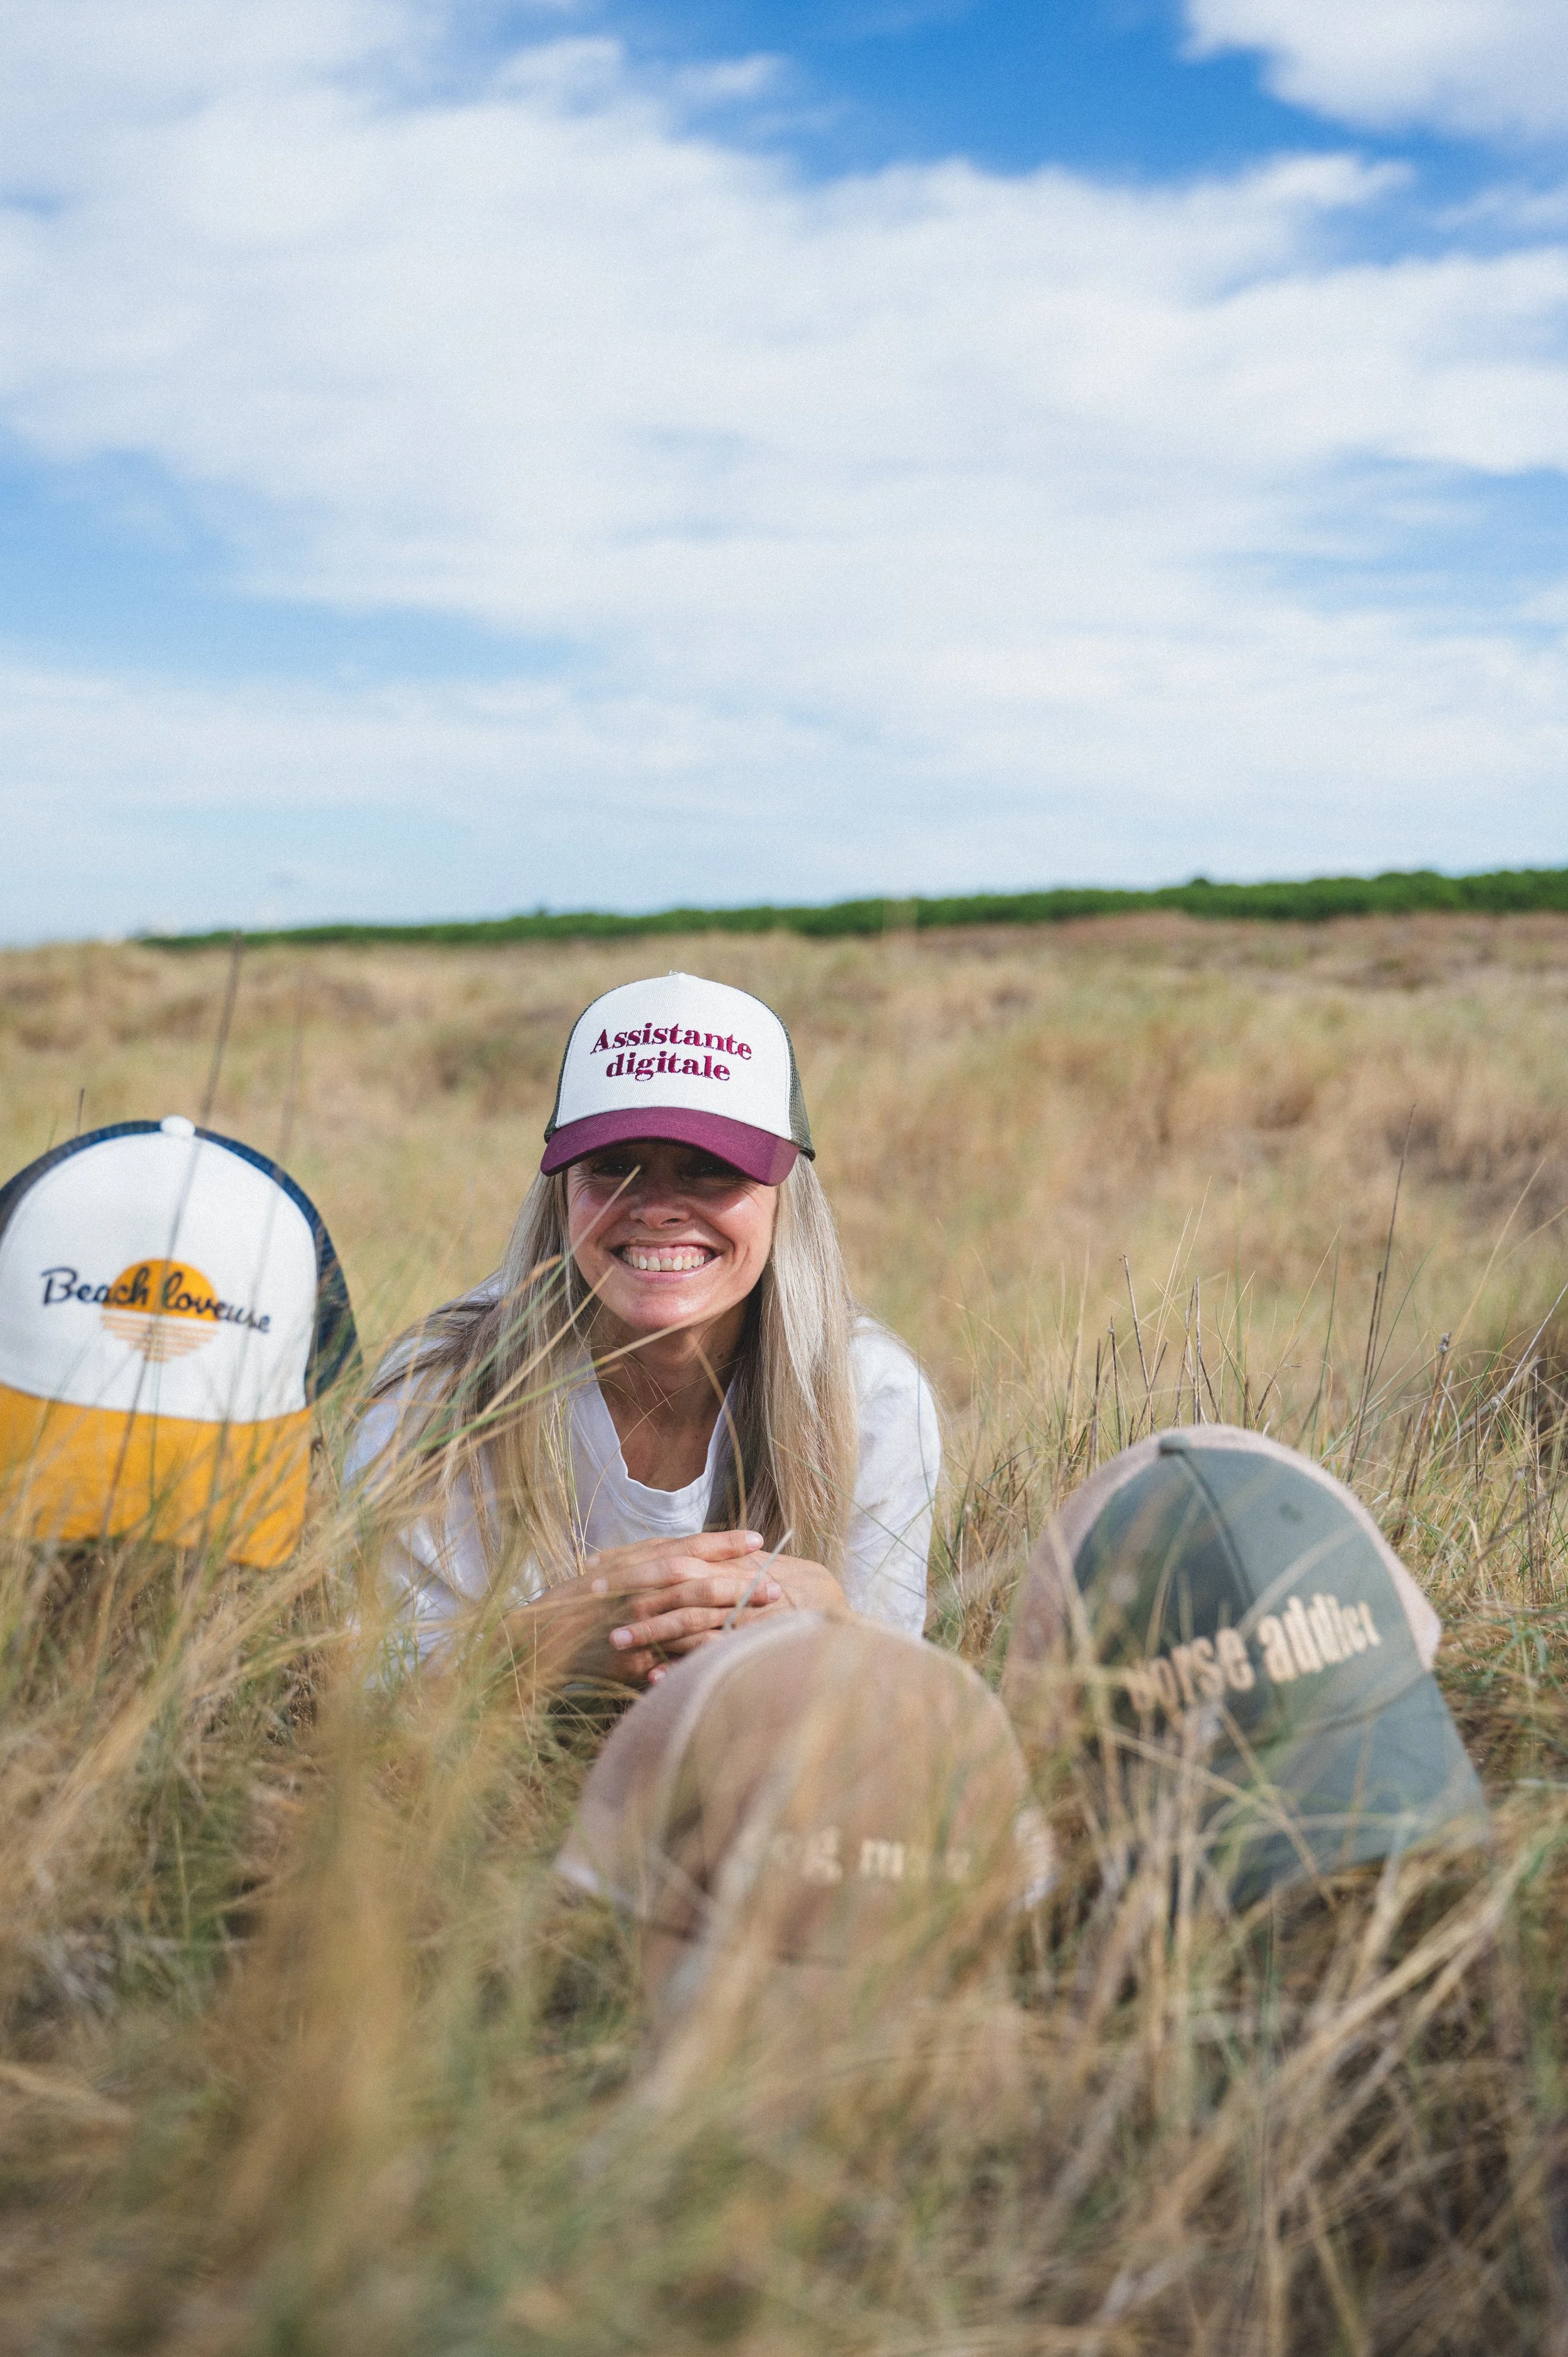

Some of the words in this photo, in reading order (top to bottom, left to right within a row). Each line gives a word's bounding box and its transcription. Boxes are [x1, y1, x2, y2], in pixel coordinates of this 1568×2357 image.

[590, 1023, 752, 1060] Assistante
[606, 1051, 730, 1082] digitale
[41, 1266, 151, 1306] Beach
[161, 1271, 270, 1333] loveuse
[1256, 1592, 1381, 1684] addict
